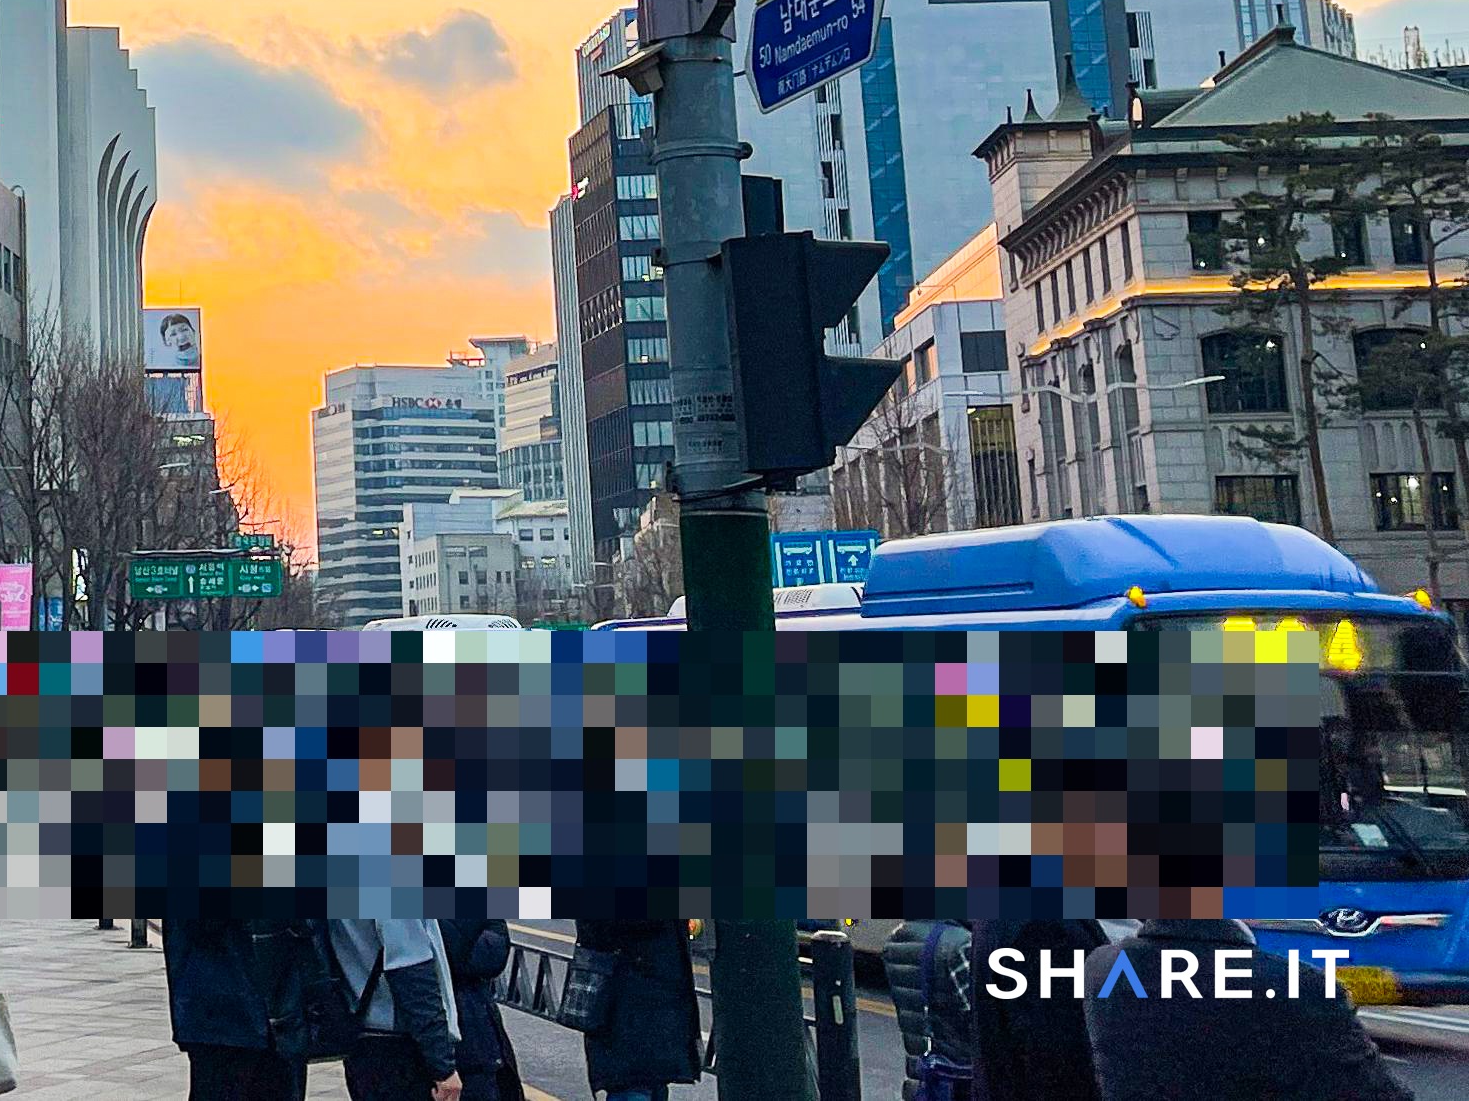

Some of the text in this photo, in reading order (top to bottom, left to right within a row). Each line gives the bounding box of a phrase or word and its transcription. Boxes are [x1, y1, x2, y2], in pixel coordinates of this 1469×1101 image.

[774, 14, 849, 66] Namdaemun-ro
[759, 43, 772, 69] 50
[392, 397, 423, 409] HSBC
